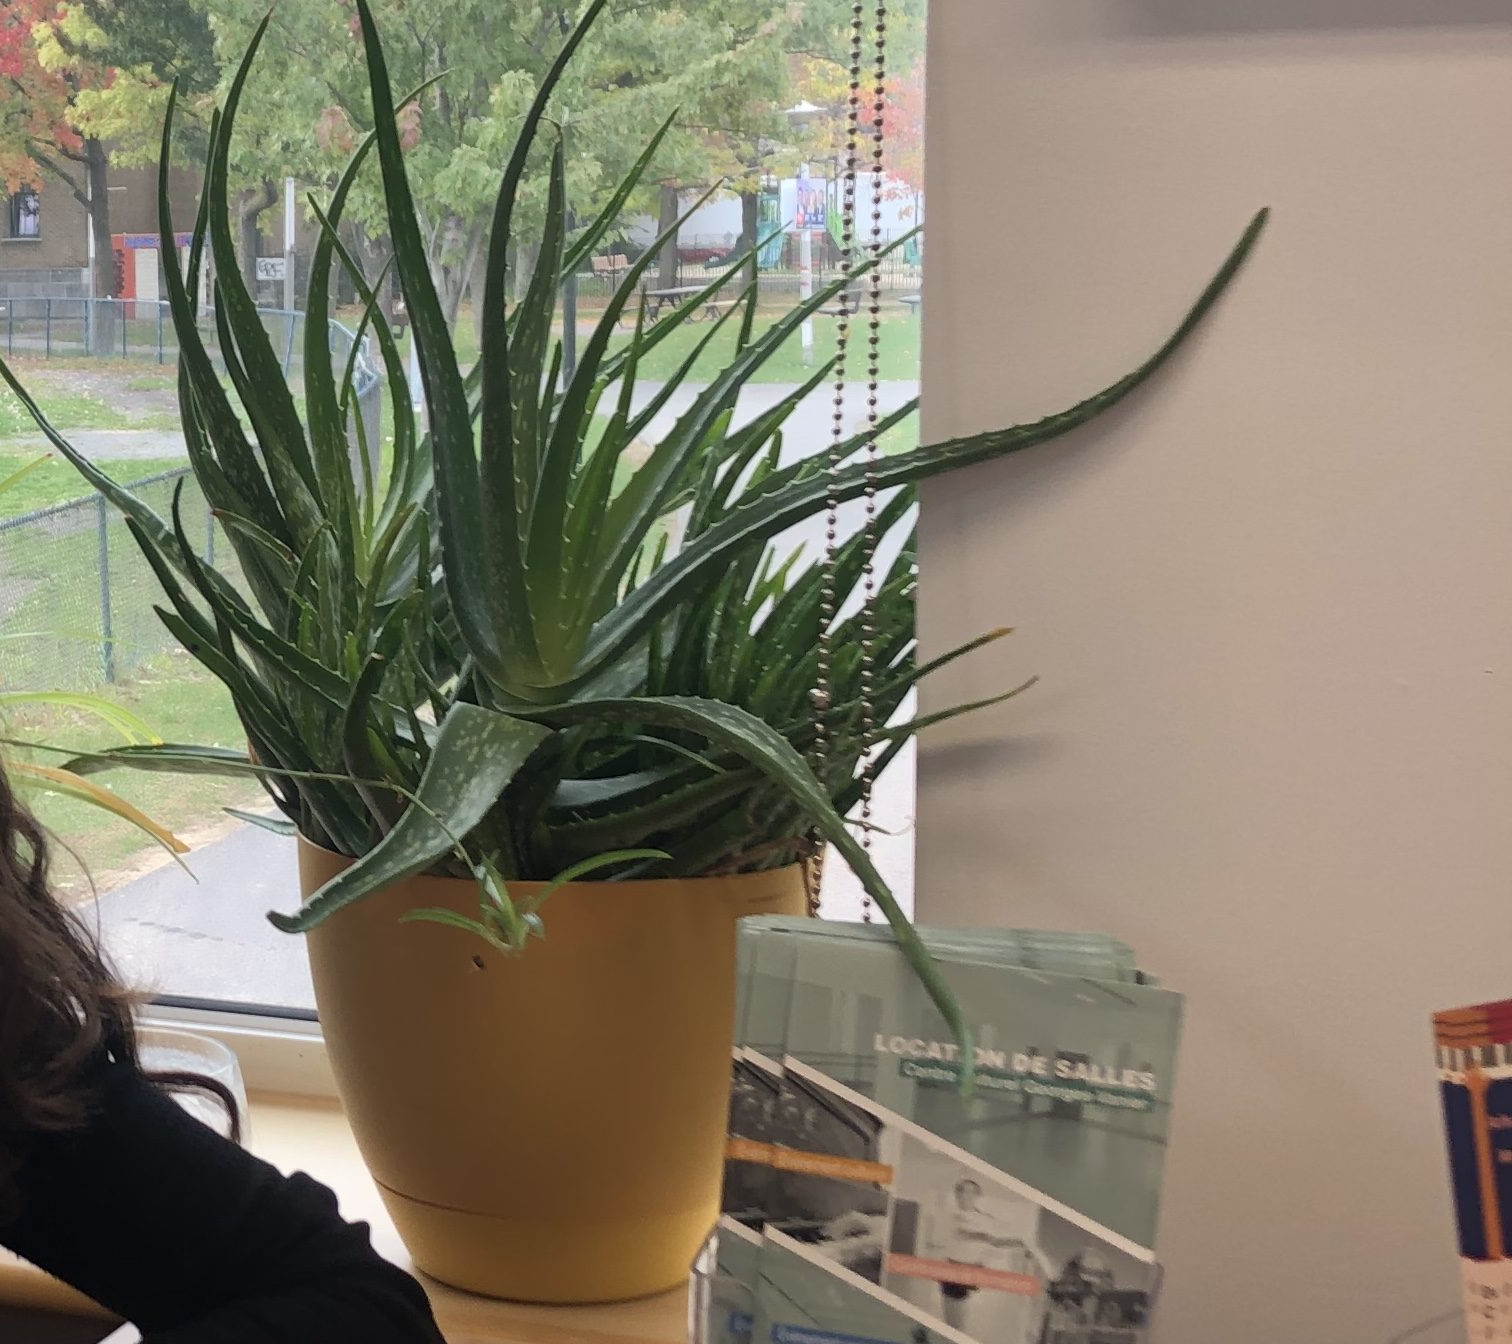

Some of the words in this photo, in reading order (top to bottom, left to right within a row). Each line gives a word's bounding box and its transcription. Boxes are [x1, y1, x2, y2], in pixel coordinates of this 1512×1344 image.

[873, 1033, 1005, 1069] LOCATON
[1013, 1051, 1048, 1076] DE
[1054, 1058, 1157, 1091] SALLES
